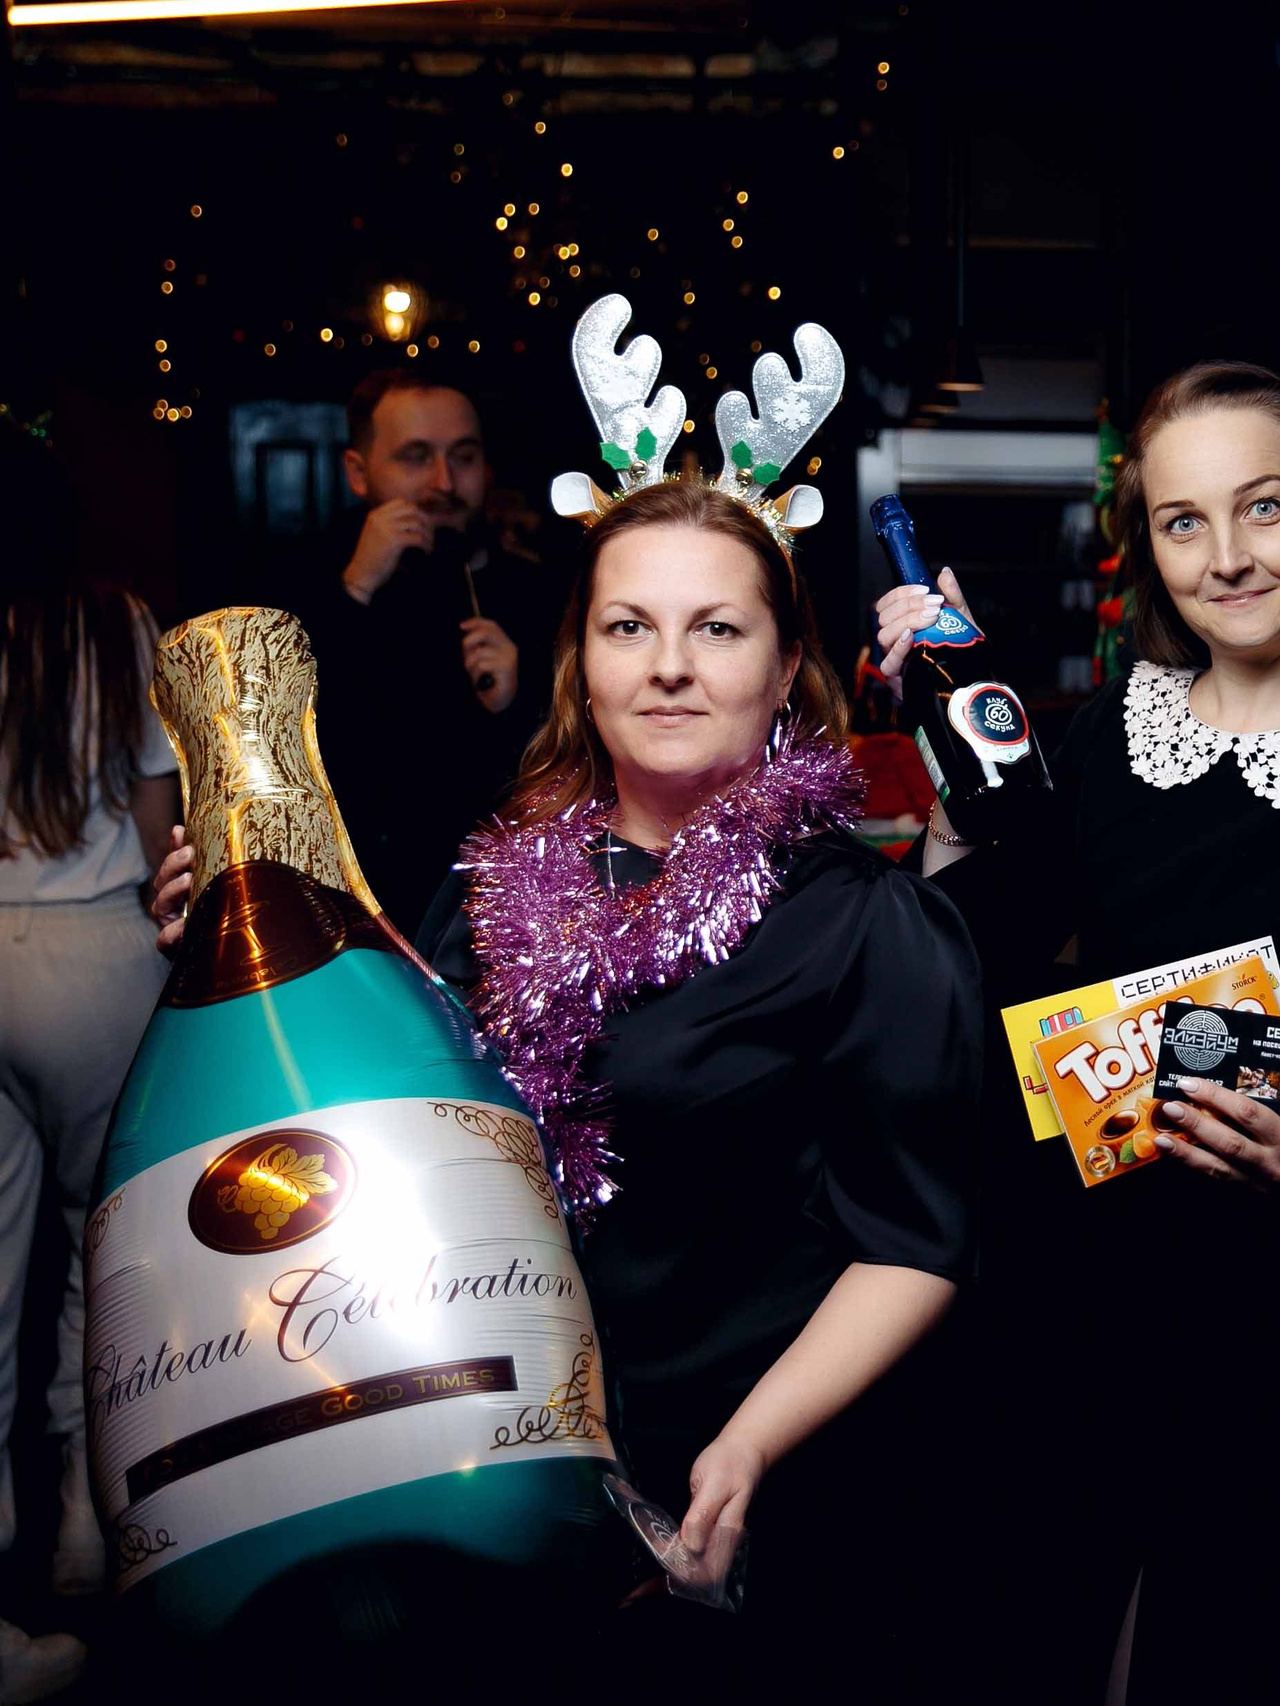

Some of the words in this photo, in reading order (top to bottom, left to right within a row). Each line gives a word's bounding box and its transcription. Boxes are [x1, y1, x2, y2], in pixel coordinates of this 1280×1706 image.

[990, 706, 1009, 721] 60
[268, 1256, 578, 1363] Célbration
[320, 1383, 403, 1417] GOOD
[411, 1368, 495, 1396] TIMES
